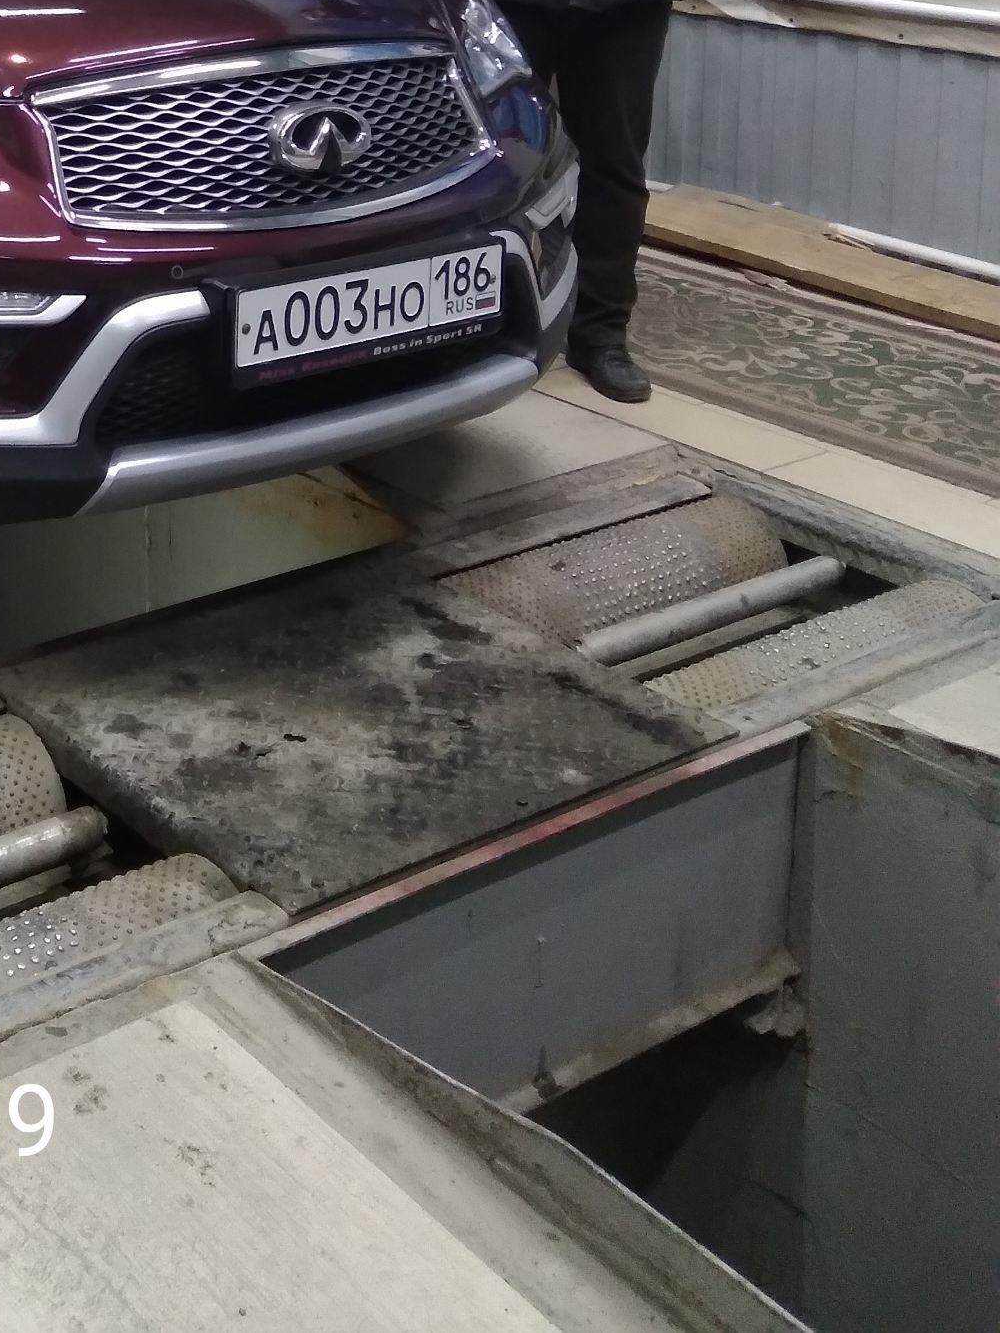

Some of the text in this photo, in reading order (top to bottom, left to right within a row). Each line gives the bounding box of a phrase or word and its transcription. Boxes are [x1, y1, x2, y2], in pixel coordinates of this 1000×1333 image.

[435, 252, 491, 299] 186
[445, 297, 474, 315] RUS
[373, 343, 407, 356] Boss
[409, 338, 423, 348] in
[426, 328, 463, 344] Sport
